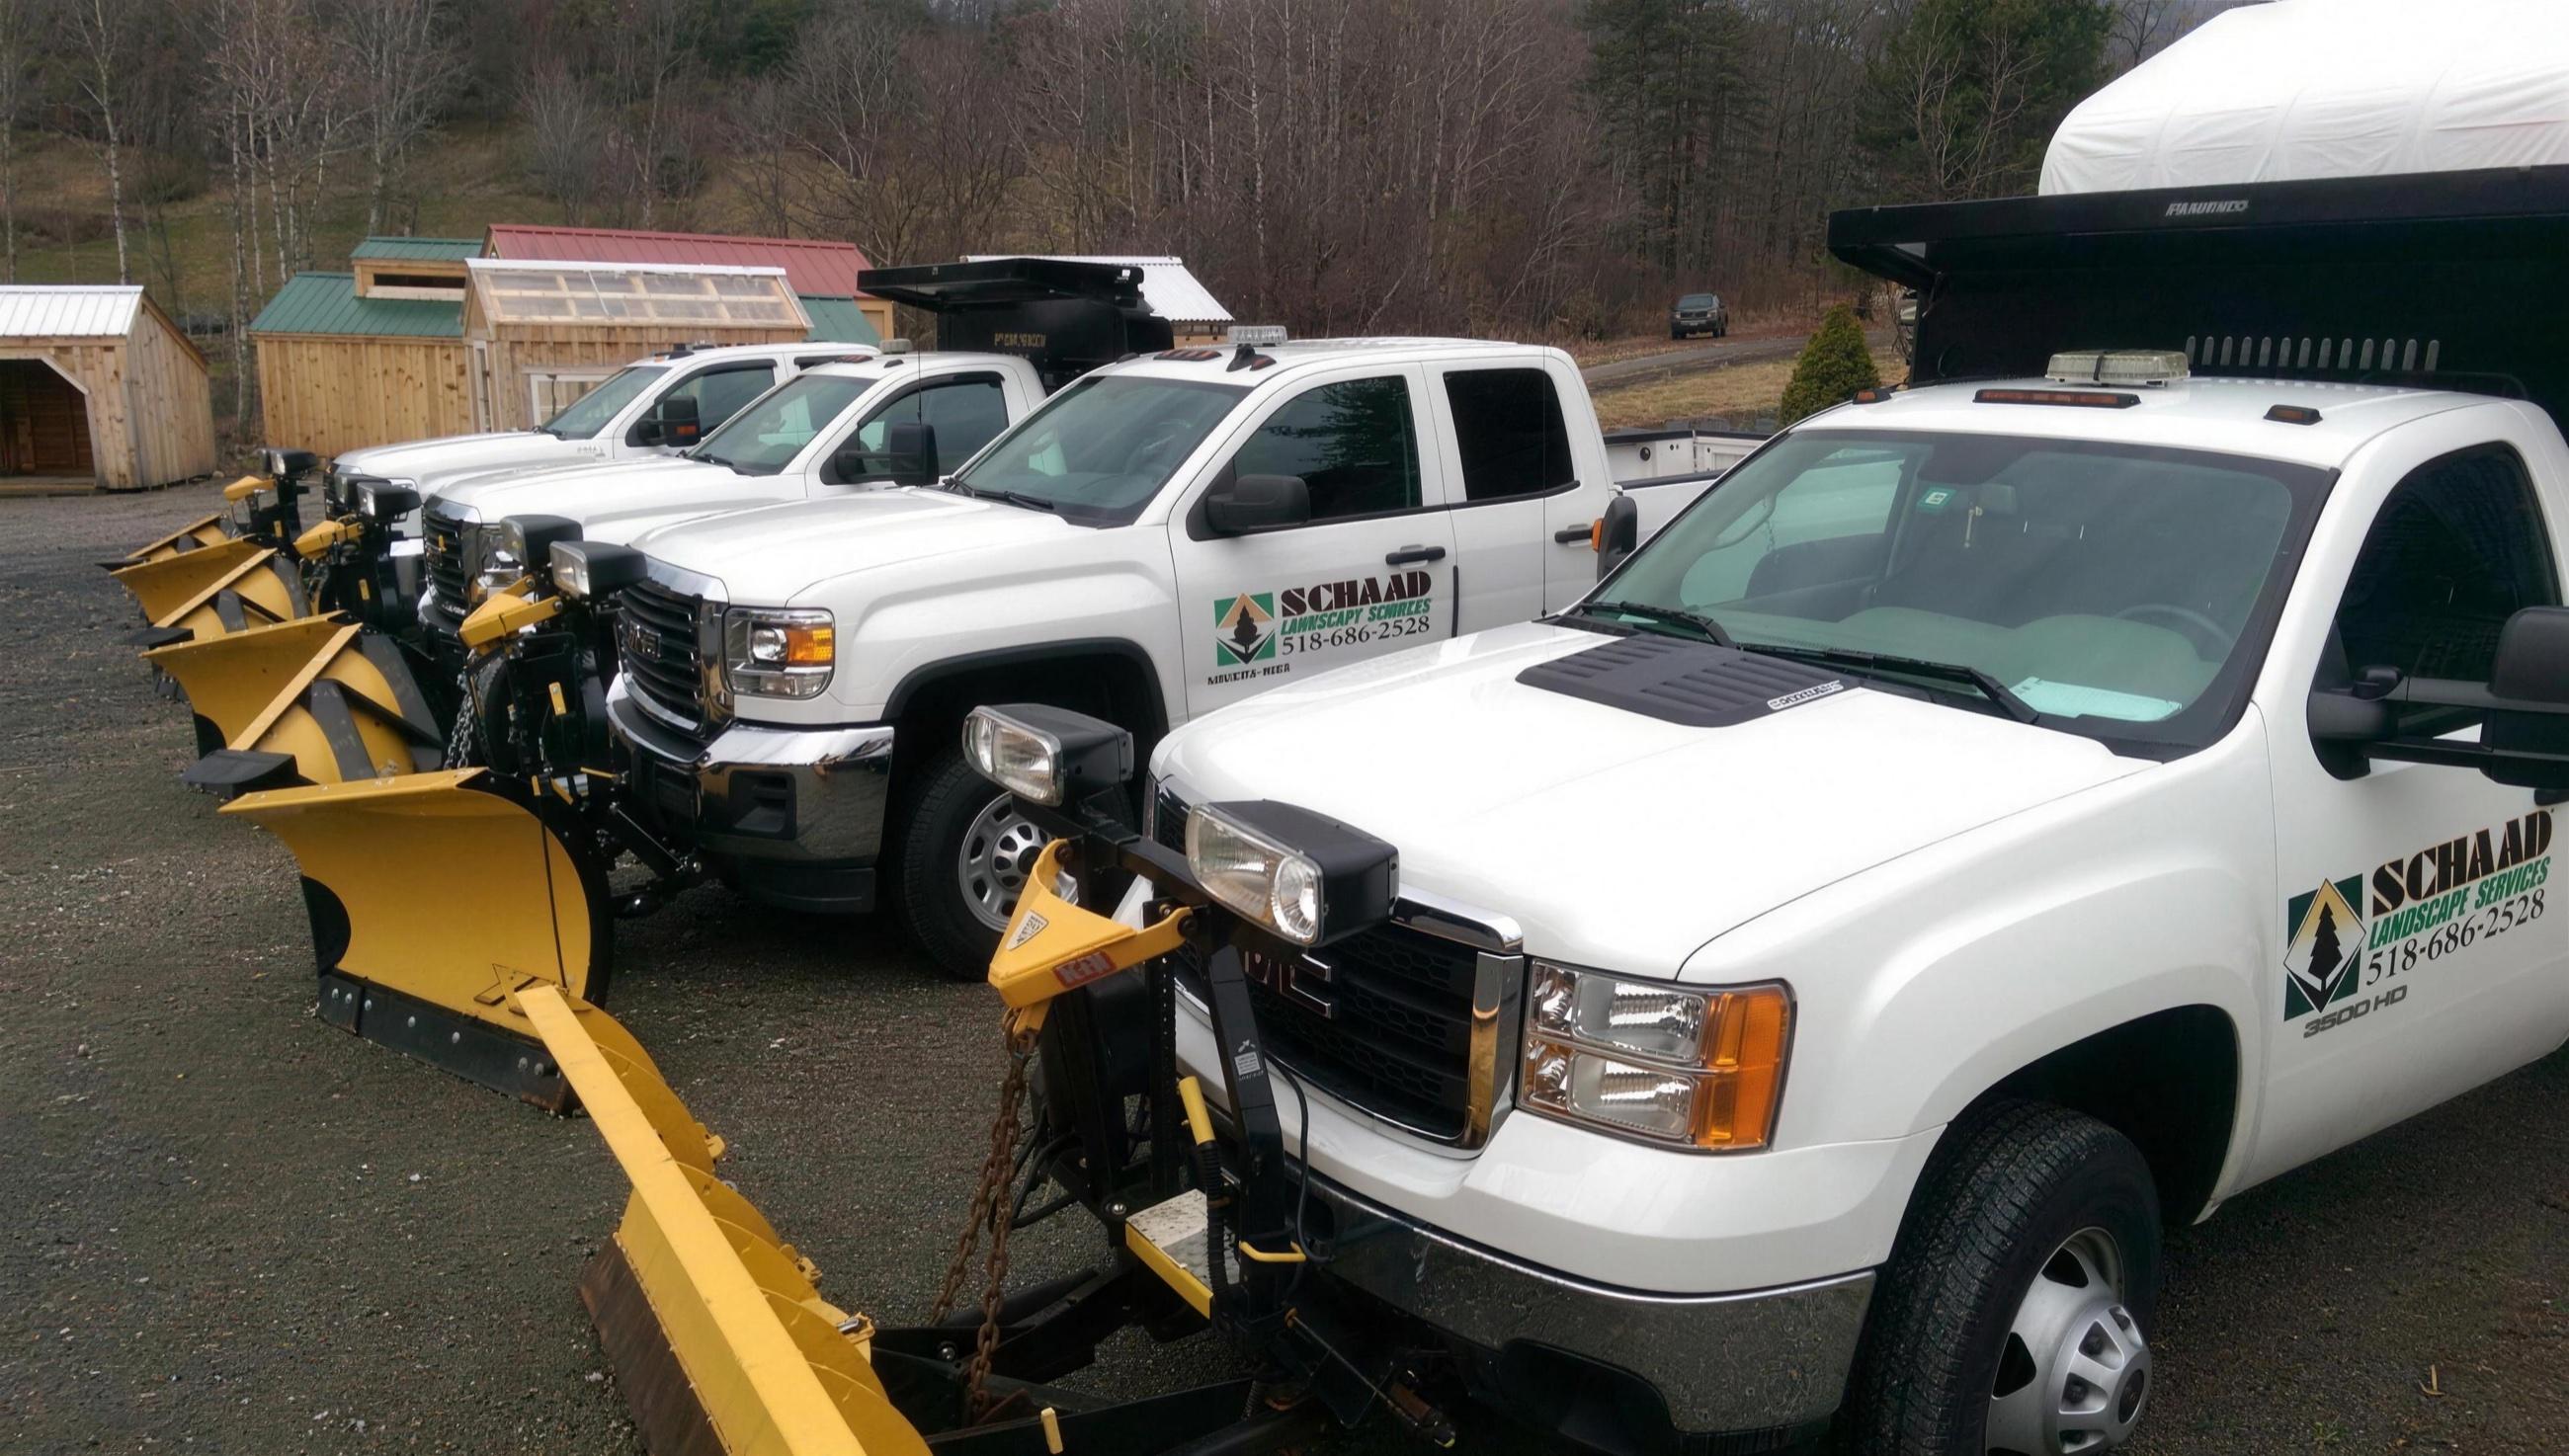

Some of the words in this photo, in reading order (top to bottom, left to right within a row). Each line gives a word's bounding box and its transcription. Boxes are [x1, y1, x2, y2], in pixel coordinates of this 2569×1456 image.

[1281, 571, 1432, 617] SCHAAD
[1282, 615, 1431, 655] 518-686-2528
[2368, 886, 2470, 950] LANDSCAPE
[2474, 855, 2551, 909] SERVICES
[2372, 810, 2552, 918] SCHAAD
[2365, 888, 2545, 986] 518-686-2528
